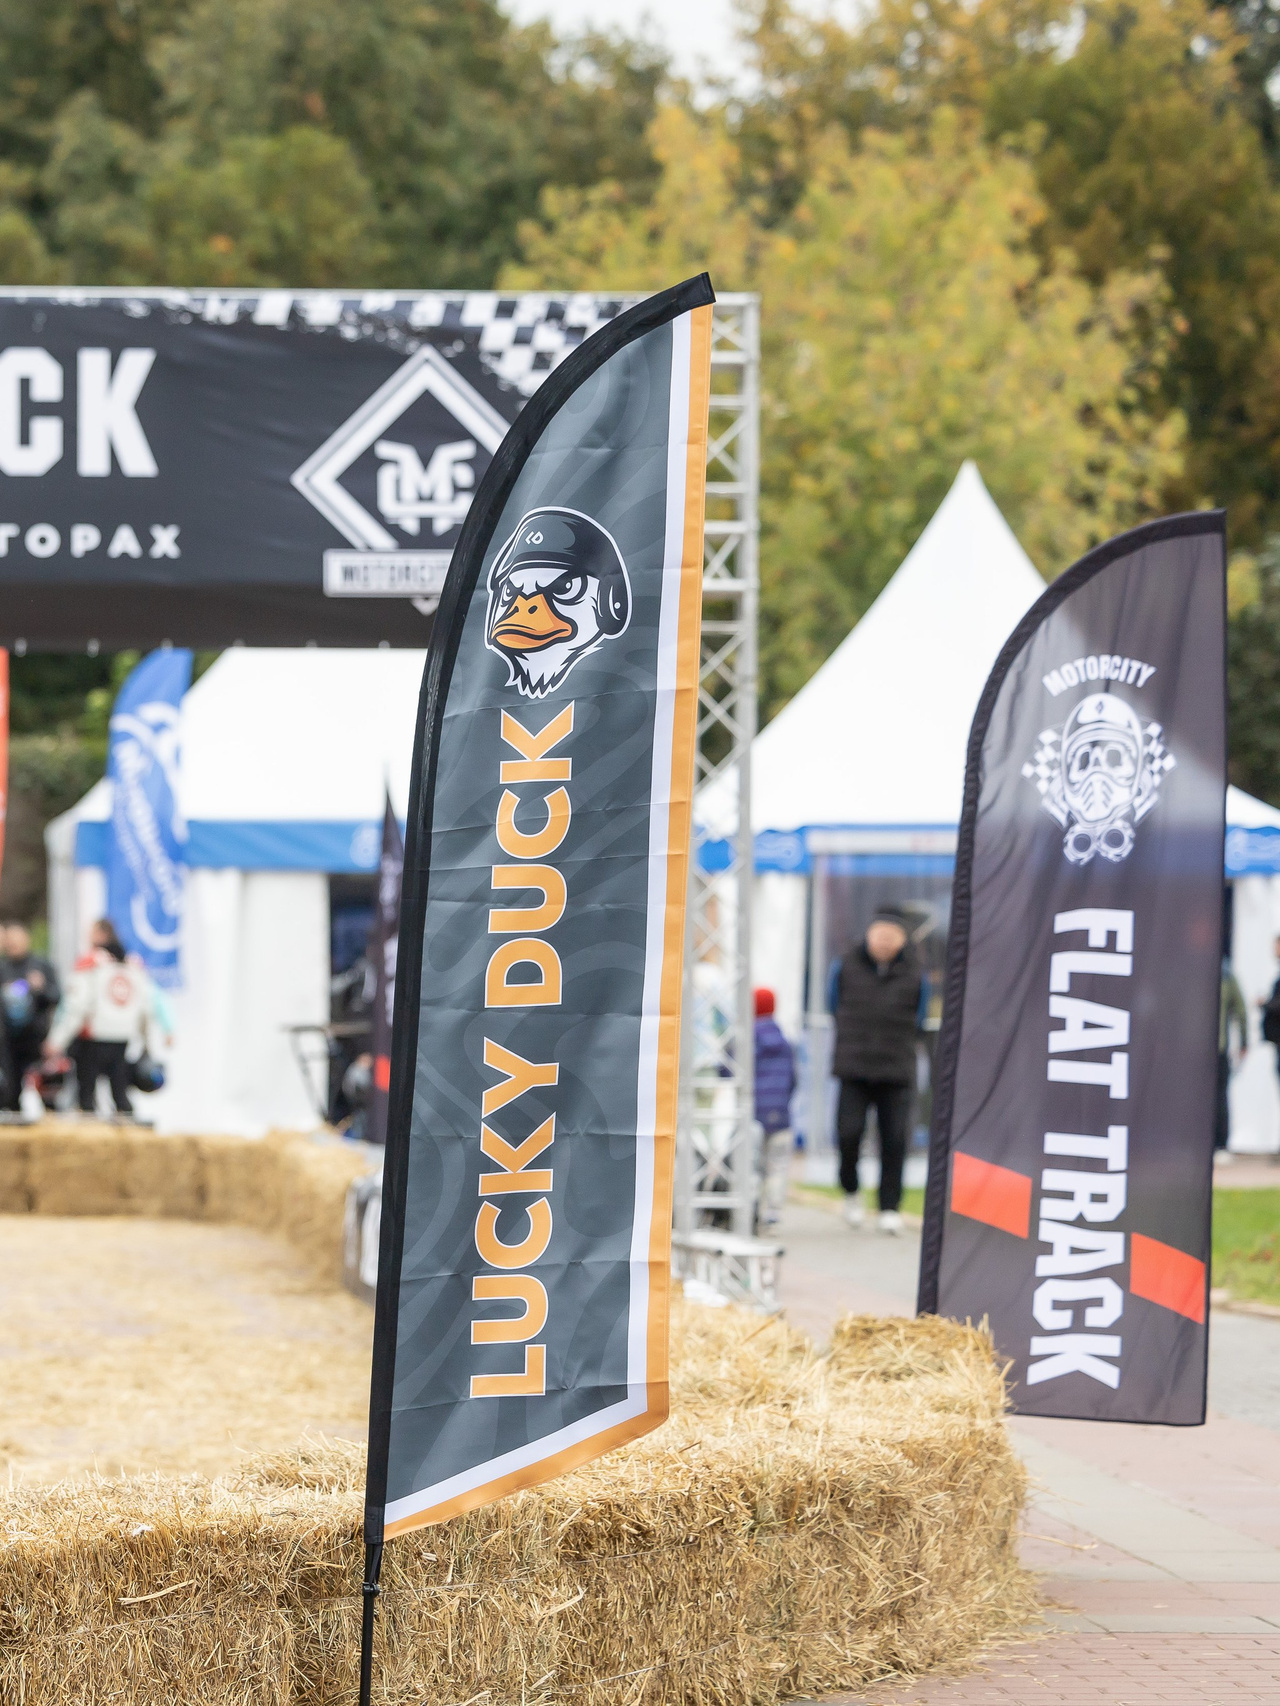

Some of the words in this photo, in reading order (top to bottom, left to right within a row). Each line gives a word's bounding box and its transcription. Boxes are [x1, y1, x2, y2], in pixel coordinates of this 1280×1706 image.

[1041, 653, 1158, 698] MOTORCITY
[483, 699, 575, 1009] DUCK
[1047, 907, 1135, 1101] FLAT
[469, 1036, 558, 1399] LUCKY
[1026, 1124, 1128, 1390] TRACK
